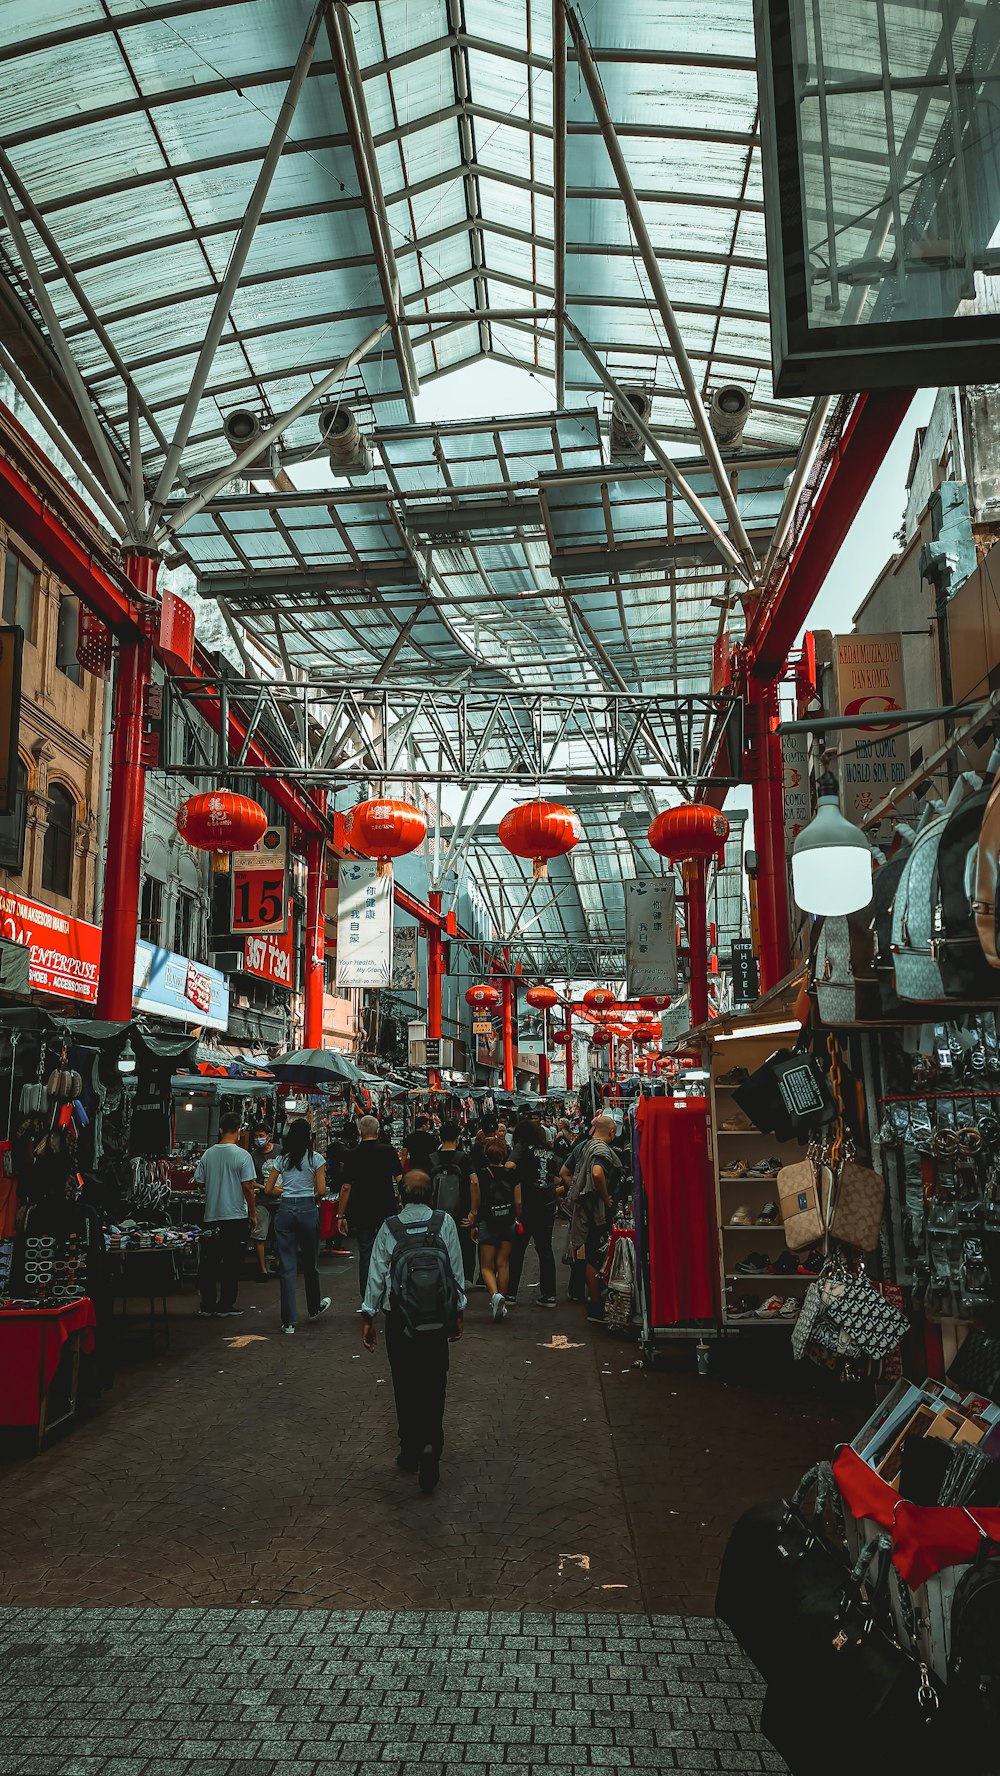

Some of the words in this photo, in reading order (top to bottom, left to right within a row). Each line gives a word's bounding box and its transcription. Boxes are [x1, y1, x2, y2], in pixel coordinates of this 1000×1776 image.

[839, 645, 860, 664] KEDAI
[886, 643, 899, 662] DVD
[852, 670, 865, 689] DAN
[866, 668, 890, 688] KOMIK
[846, 763, 870, 782] WORLD
[236, 880, 282, 923] 15
[366, 886, 376, 919] 你健康
[30, 945, 97, 980] ENTERPRISE
[246, 936, 267, 971] 367
[269, 945, 290, 981] 7321
[740, 953, 751, 997] HOTEL
